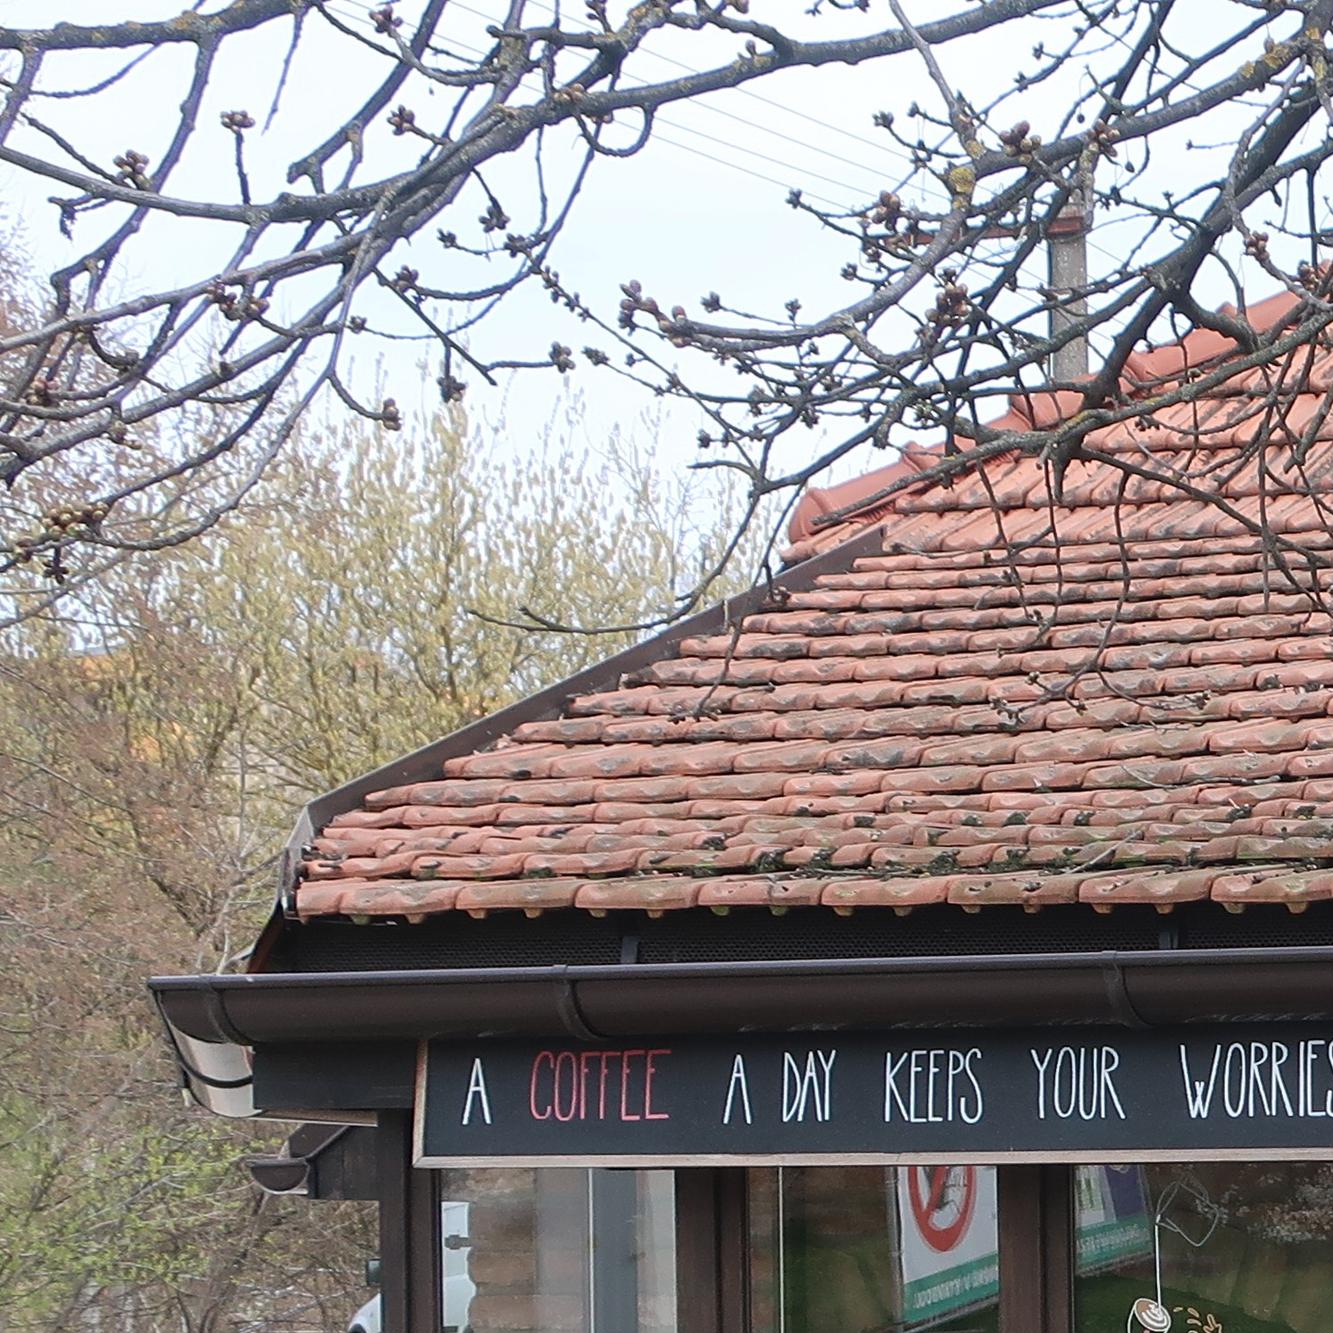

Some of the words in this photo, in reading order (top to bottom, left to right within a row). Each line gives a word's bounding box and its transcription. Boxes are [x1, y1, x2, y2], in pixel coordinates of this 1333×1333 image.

[461, 1057, 493, 1126] A
[529, 1048, 672, 1122] COFFEE
[722, 1053, 753, 1126] A
[782, 1048, 838, 1124] DAY
[882, 1046, 984, 1125] KEEPS
[1030, 1045, 1127, 1121] YOUR
